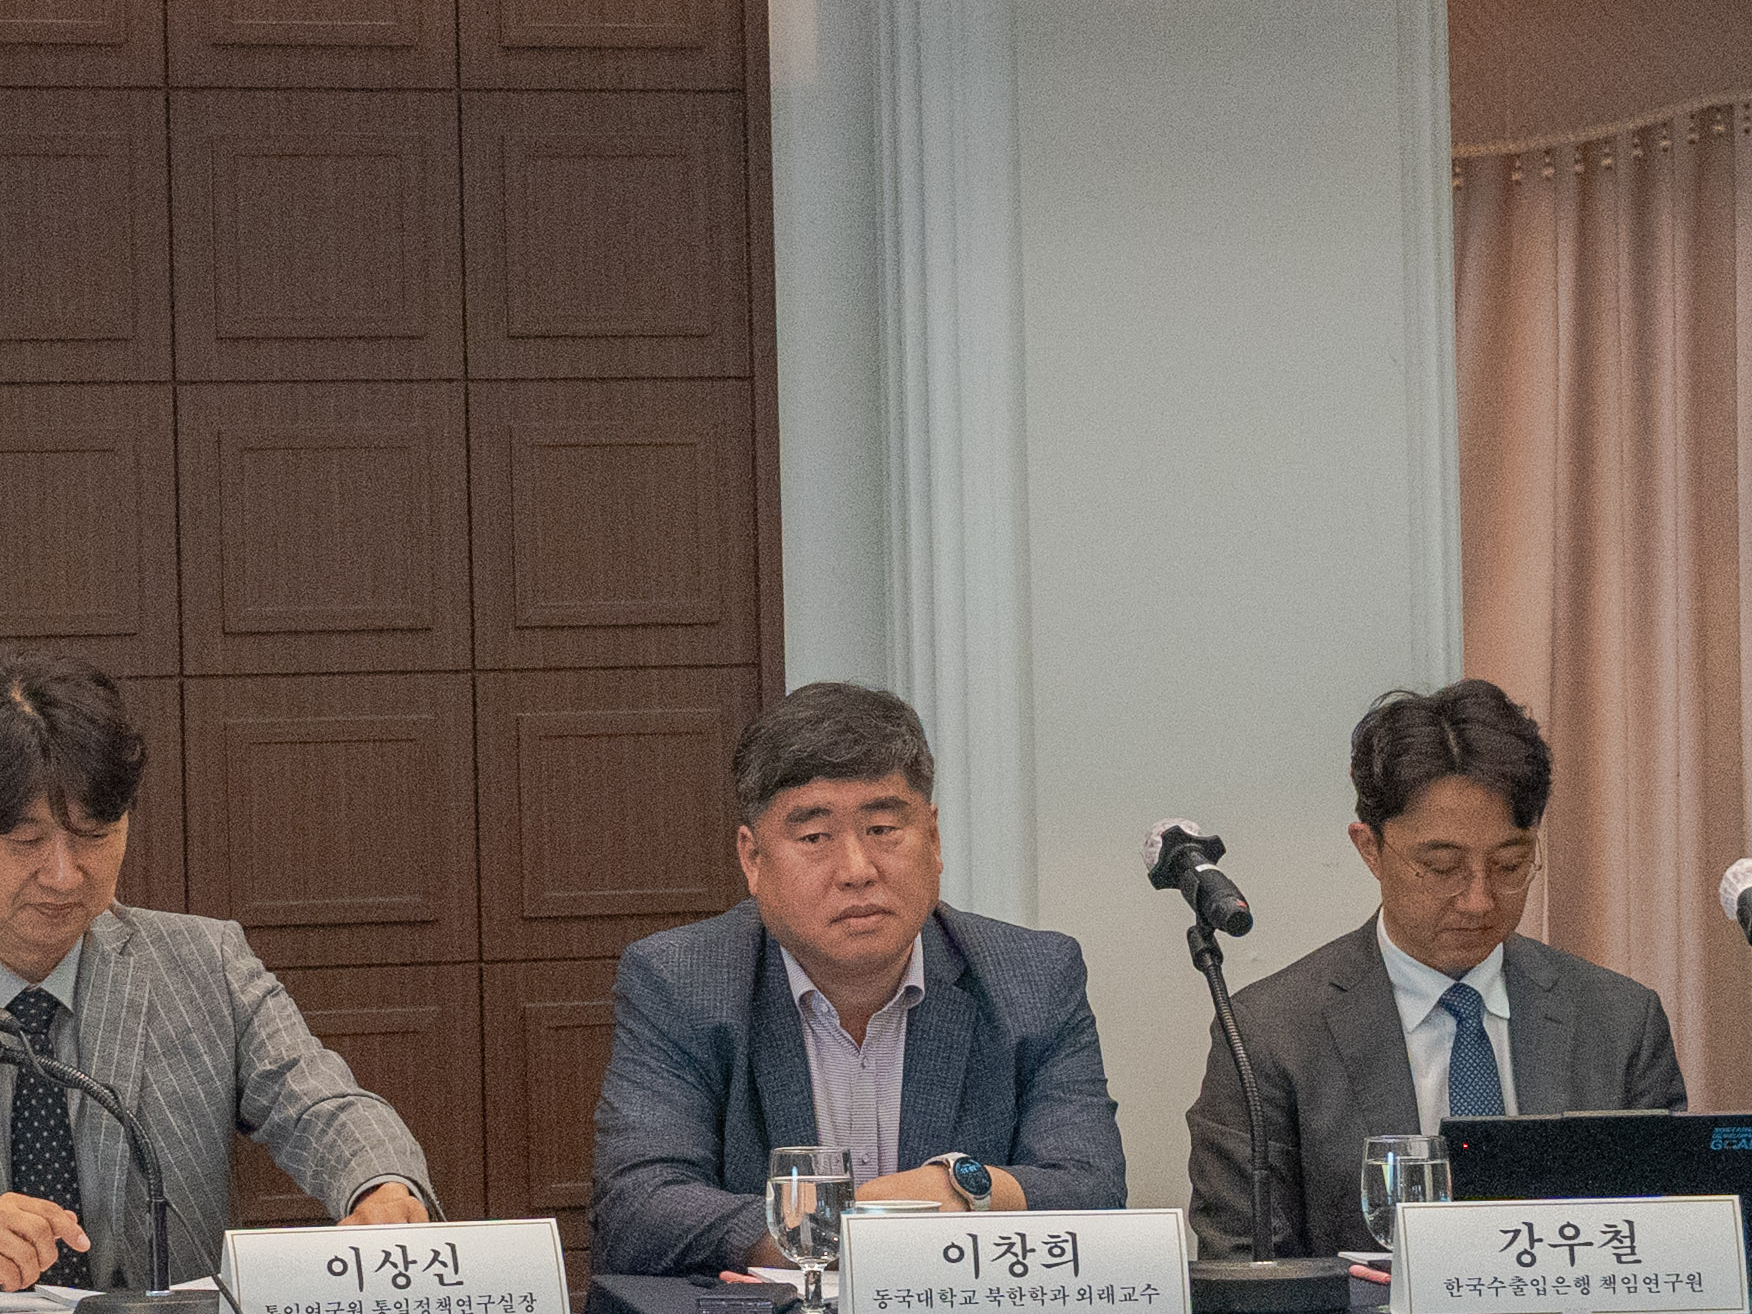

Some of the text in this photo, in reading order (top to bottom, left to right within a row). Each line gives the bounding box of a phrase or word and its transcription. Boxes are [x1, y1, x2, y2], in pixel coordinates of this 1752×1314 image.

[326, 1242, 465, 1293] 이상신
[942, 1230, 1081, 1280] 이창희
[1500, 1218, 1643, 1270] 강우철
[872, 1283, 1161, 1311] 동국대학교 북한학과 외래교수
[1443, 1271, 1704, 1299] 한국수출입은행 책임연구원
